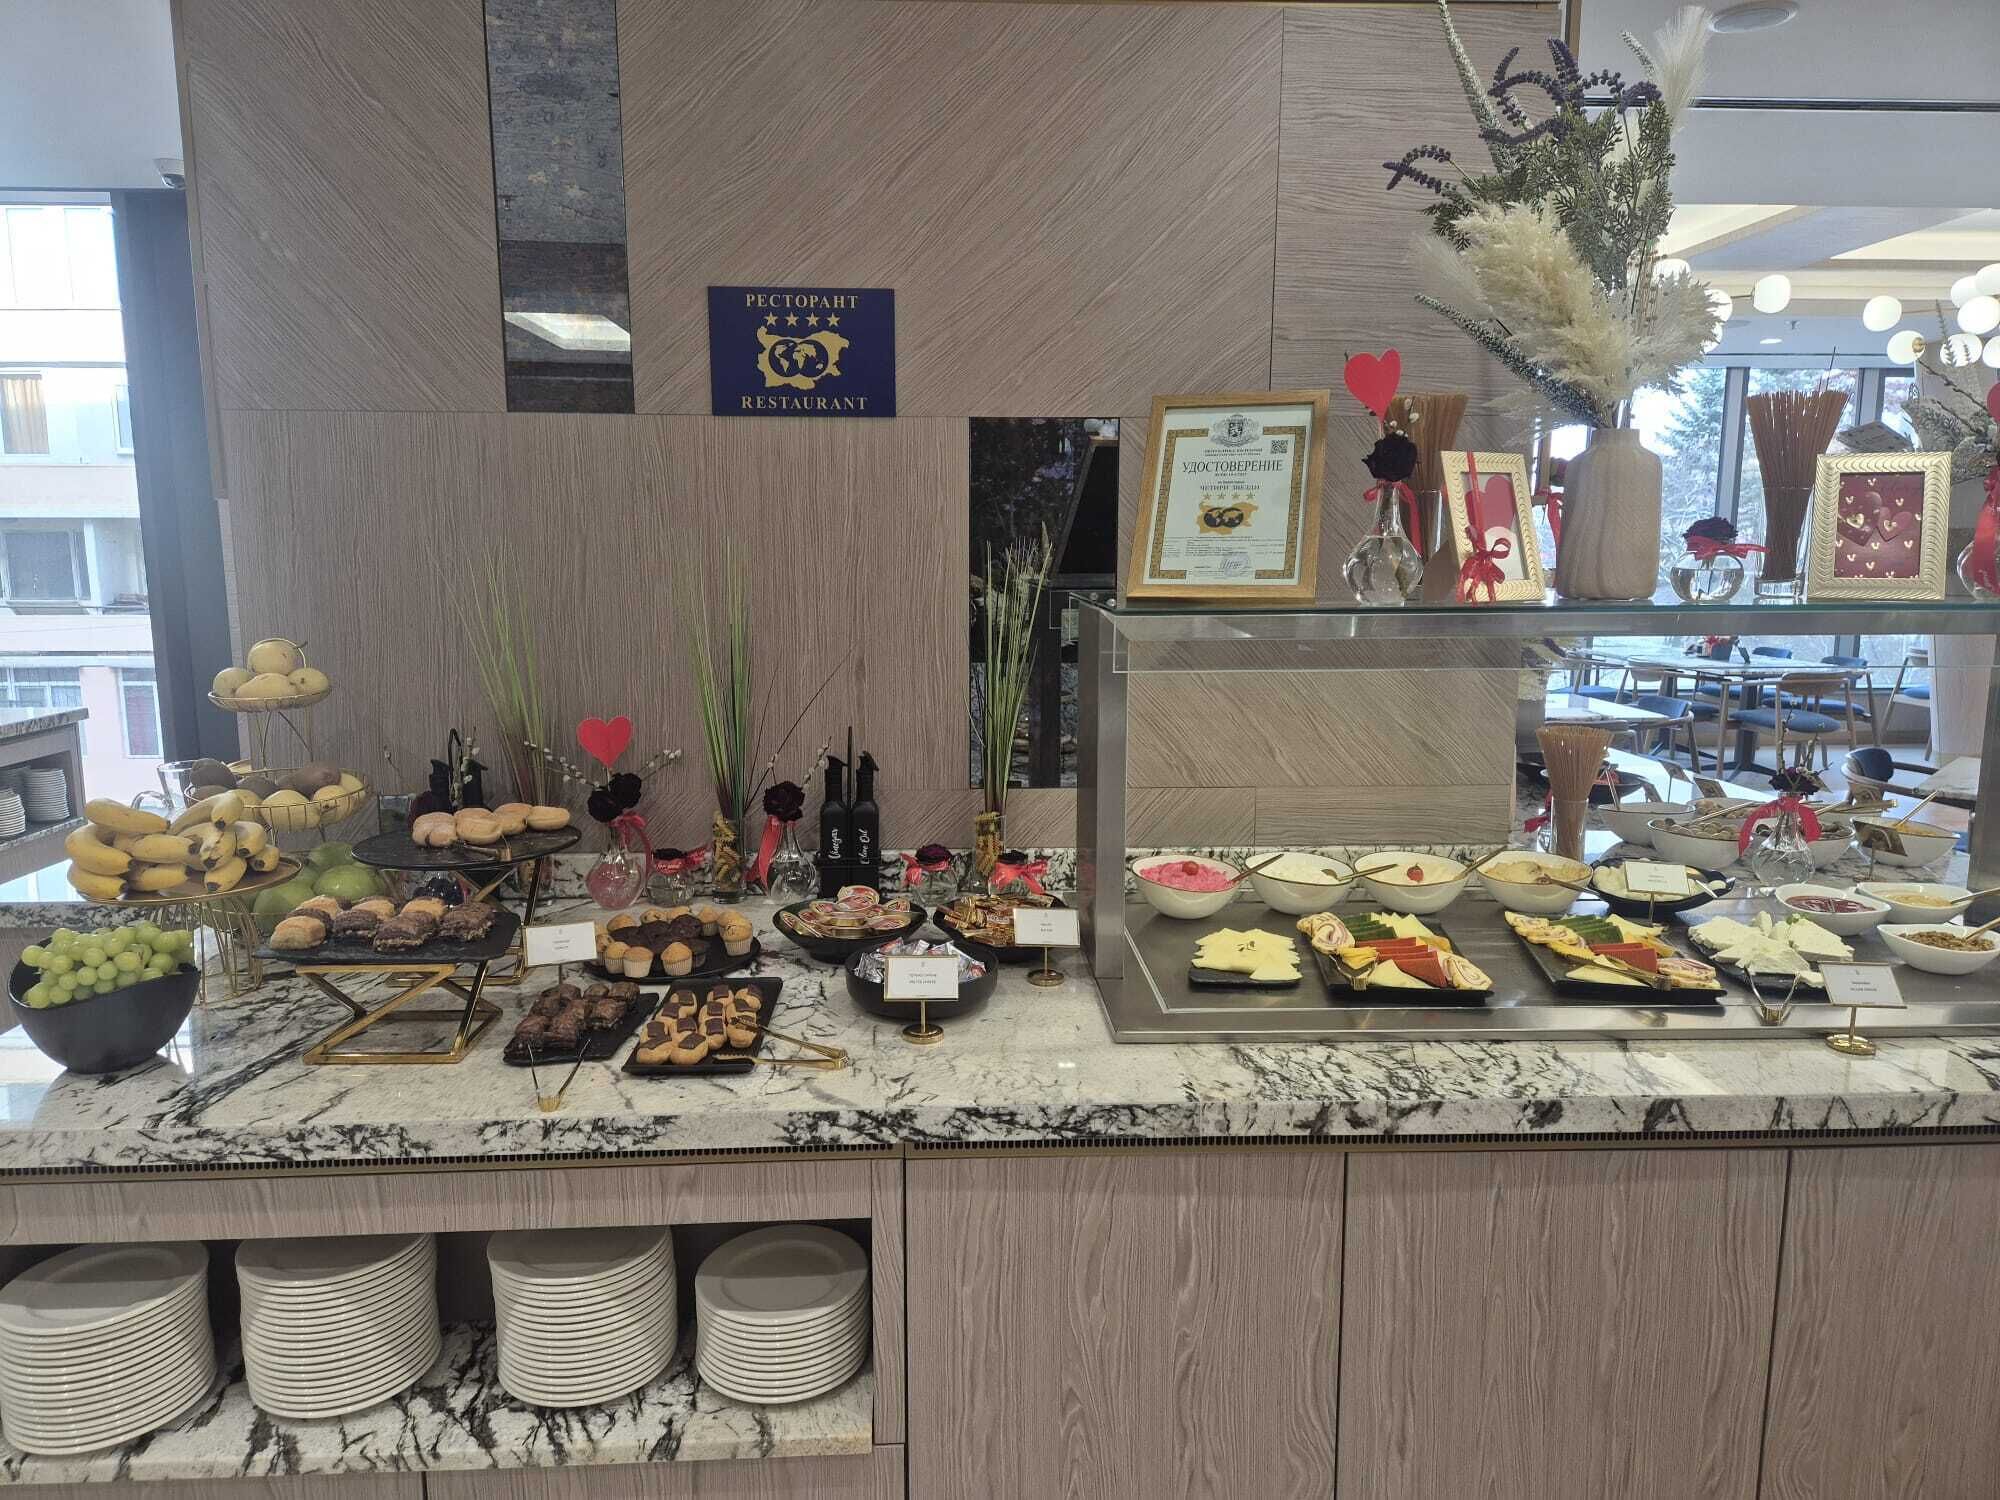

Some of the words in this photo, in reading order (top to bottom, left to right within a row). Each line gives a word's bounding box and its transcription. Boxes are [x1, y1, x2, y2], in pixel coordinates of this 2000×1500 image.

[746, 294, 859, 309] РЕСТОРАНТ
[741, 395, 867, 410] RESTAURANT
[1182, 459, 1284, 474] УДОСТОВЕРЕНИЕ
